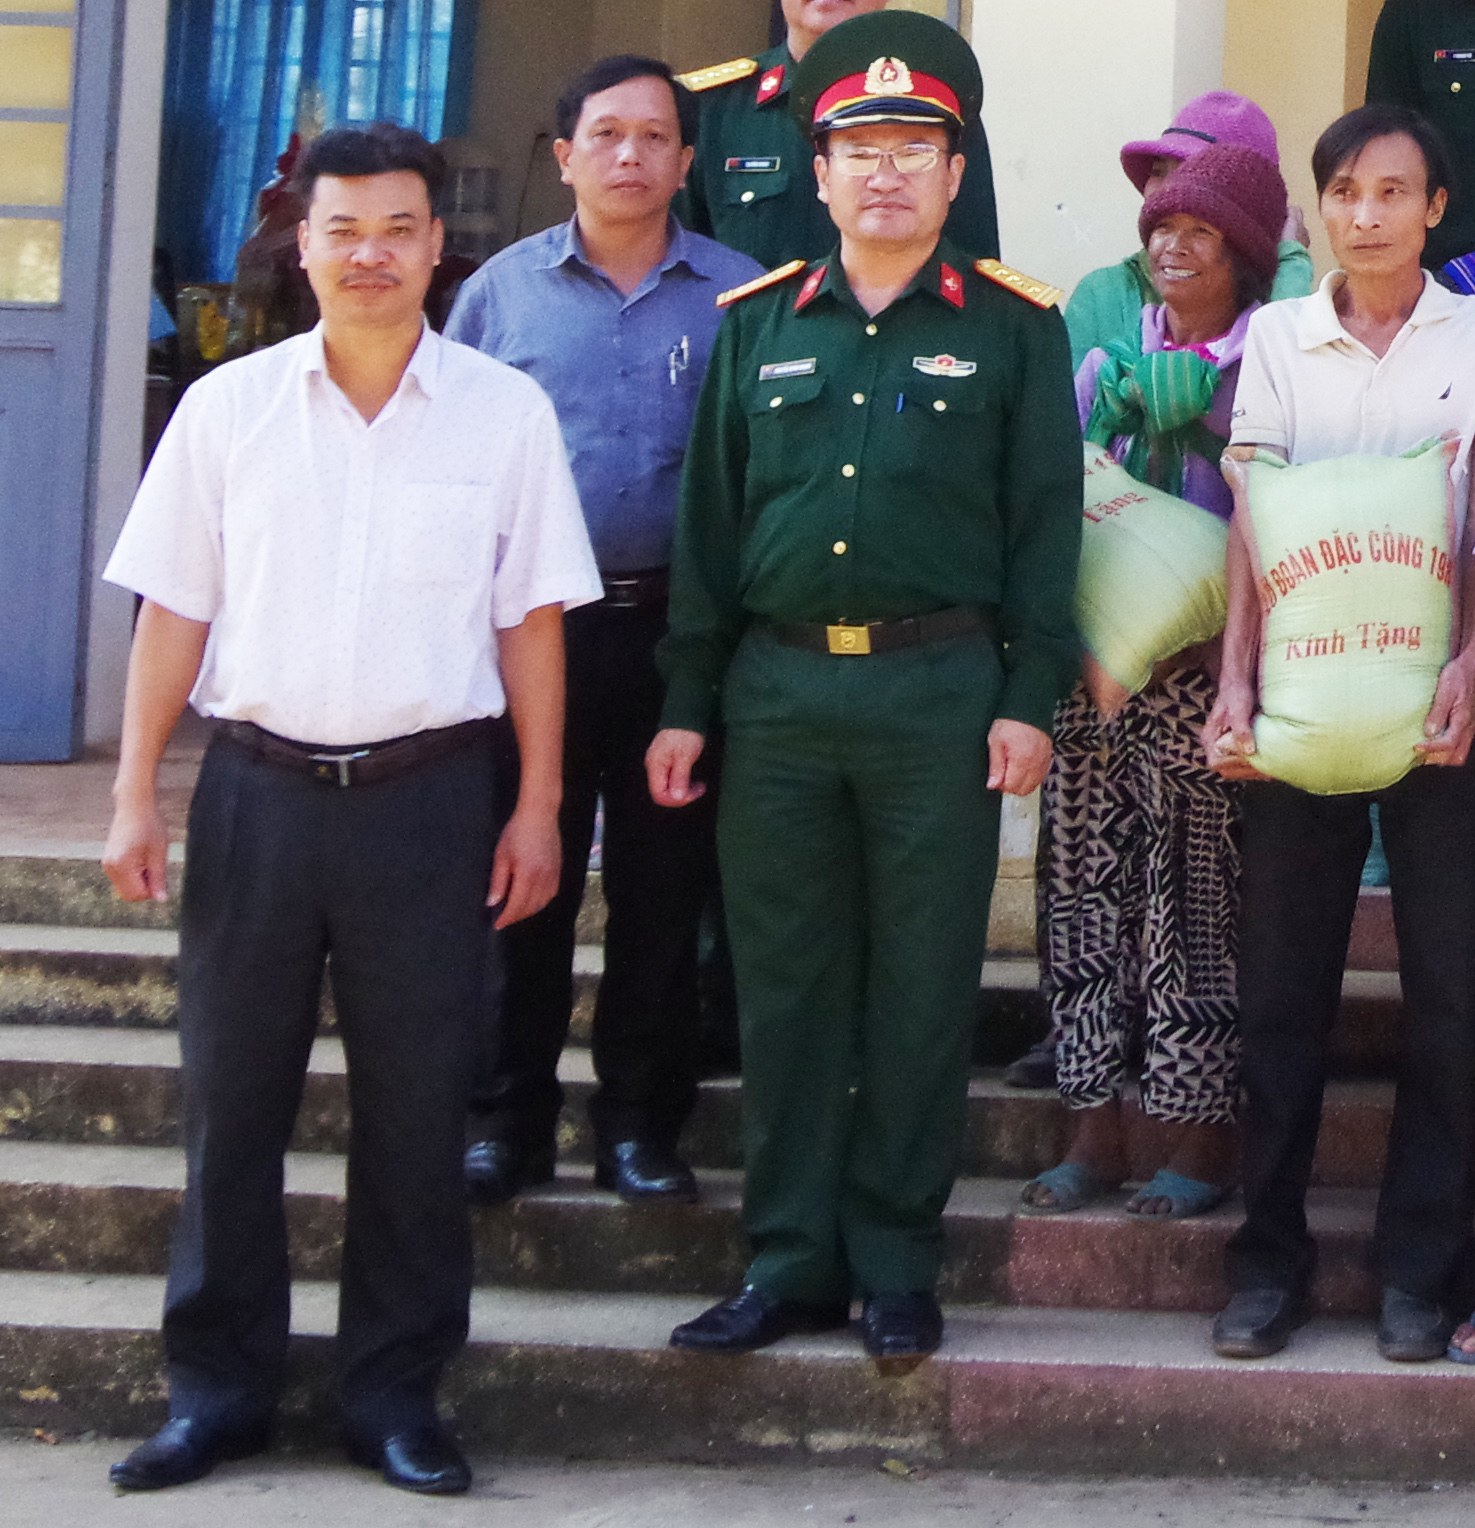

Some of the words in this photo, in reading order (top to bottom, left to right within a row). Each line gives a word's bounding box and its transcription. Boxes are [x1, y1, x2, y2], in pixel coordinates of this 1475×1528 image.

[1318, 528, 1362, 574] ĐẶC
[1368, 524, 1423, 569] CÔNG
[1357, 621, 1421, 654] Tặng
